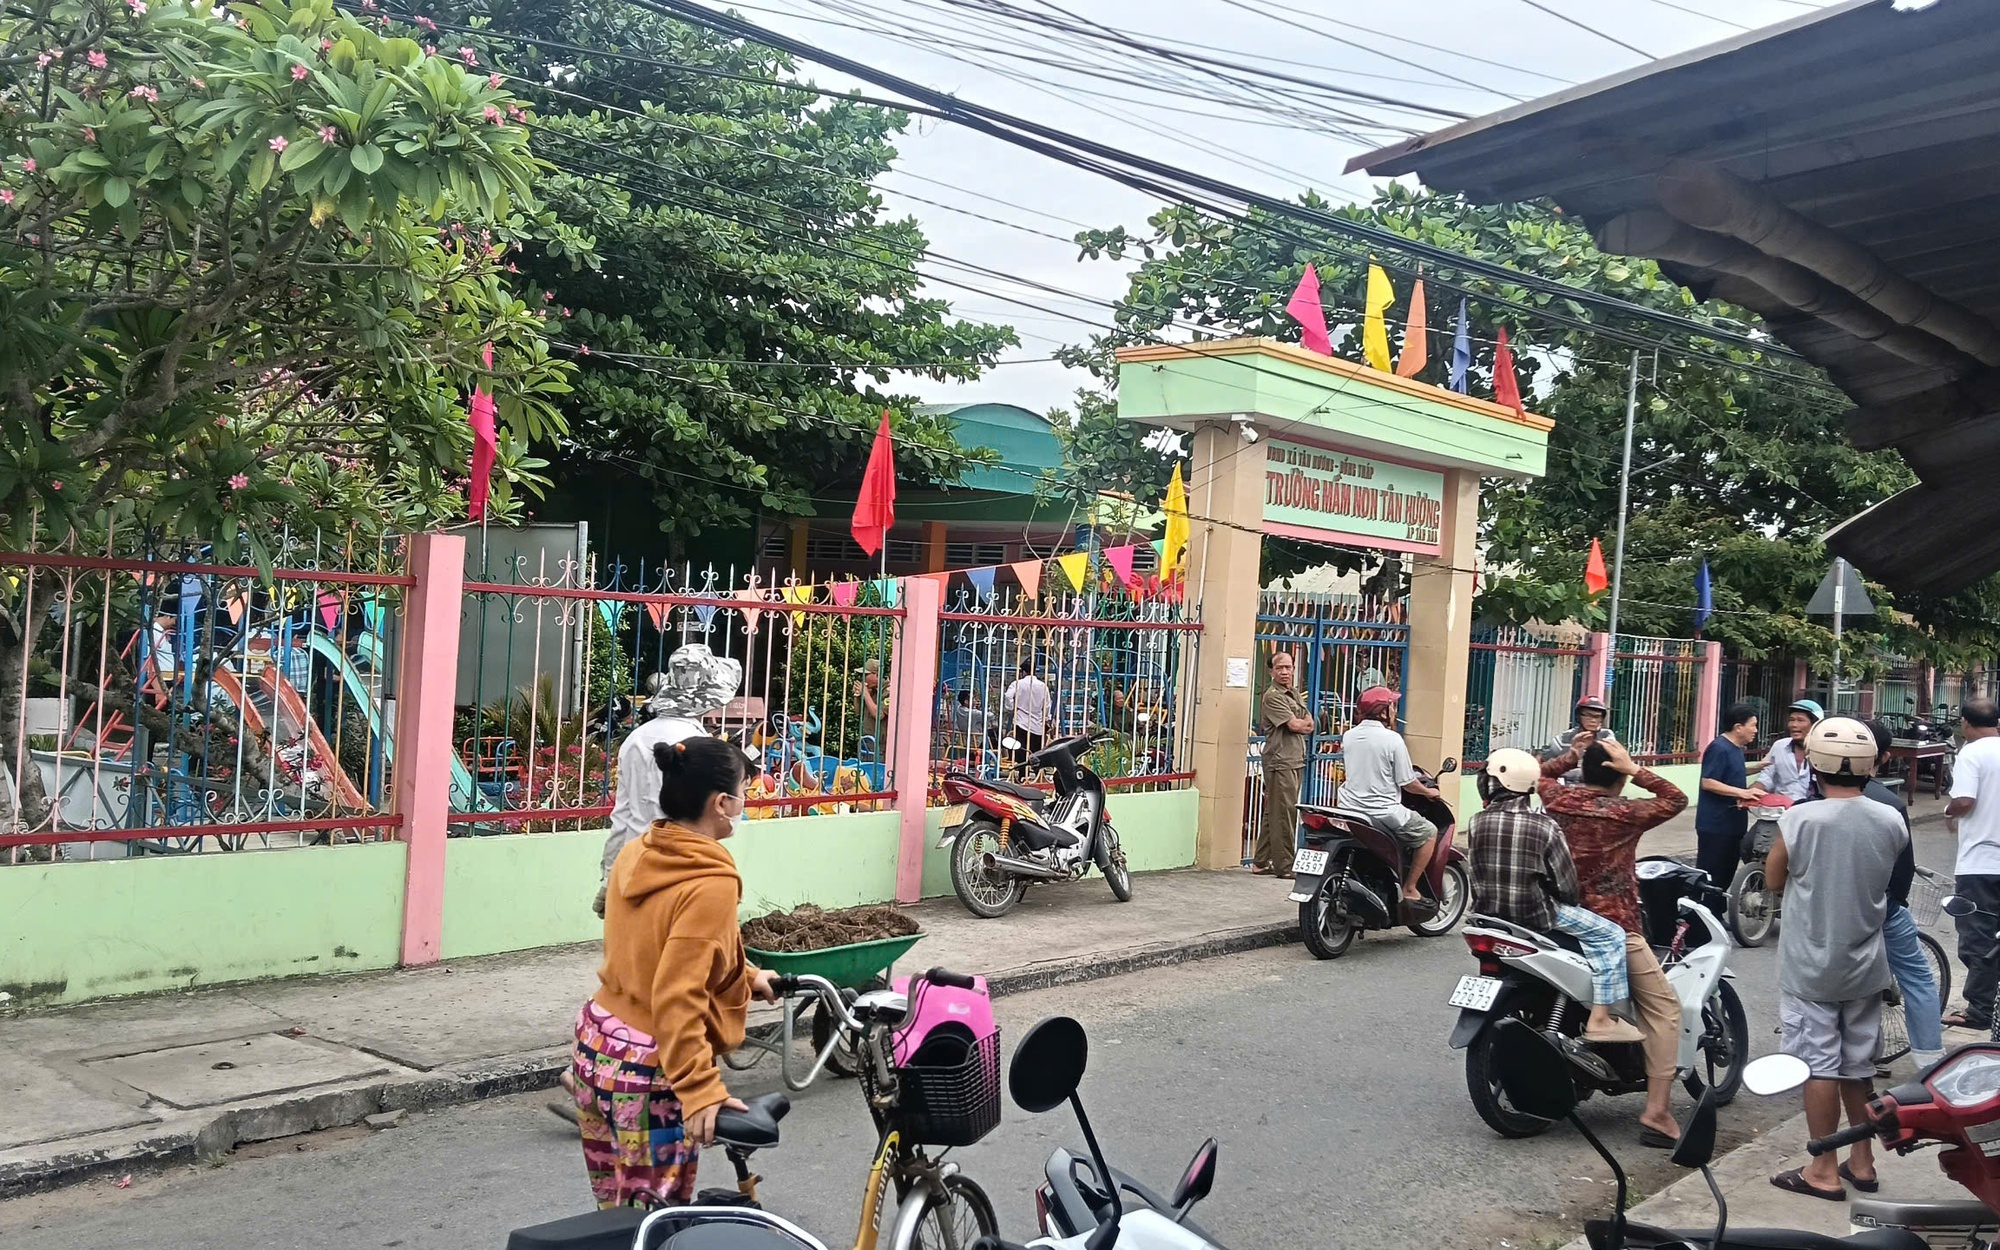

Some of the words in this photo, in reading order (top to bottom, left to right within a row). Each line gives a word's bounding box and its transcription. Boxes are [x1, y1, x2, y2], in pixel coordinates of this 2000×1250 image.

[1298, 450, 1311, 468] TÂN
[1357, 463, 1374, 480] THÁP
[1265, 468, 1320, 512] TRƯỜNG
[1319, 474, 1351, 516] MẦM
[1350, 484, 1378, 521] NON
[1379, 484, 1403, 523] TÂN
[1402, 491, 1440, 530] HƯƠNG
